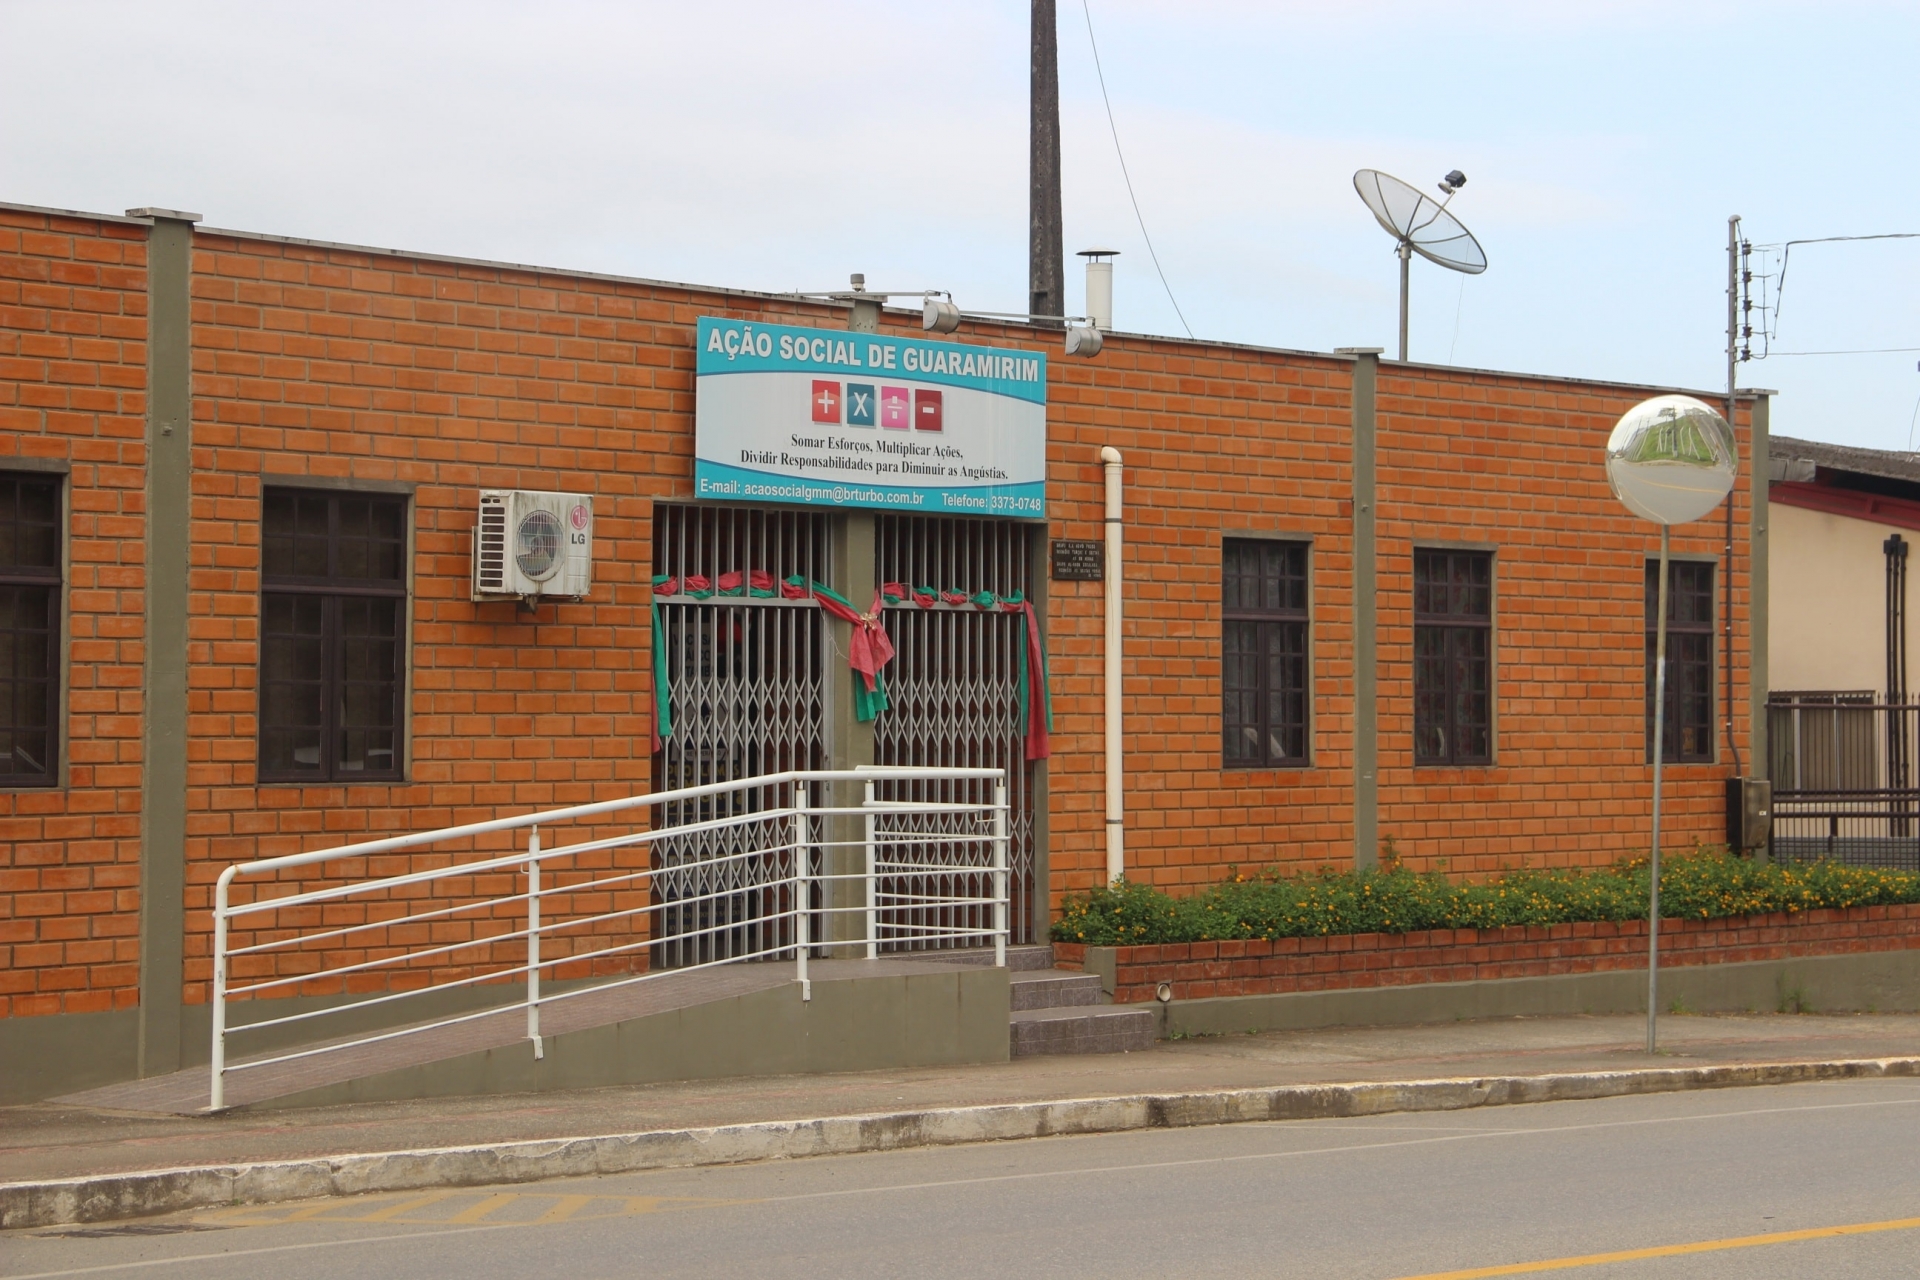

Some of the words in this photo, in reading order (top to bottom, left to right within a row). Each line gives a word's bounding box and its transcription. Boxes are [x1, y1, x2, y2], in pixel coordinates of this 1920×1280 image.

[707, 326, 773, 361] AÇÃO
[779, 335, 862, 366] SOCIAL
[868, 343, 897, 370] DE
[903, 347, 1039, 382] GUARAMIRIM
[791, 434, 825, 449] Somar
[828, 436, 873, 454] Esforços,
[876, 440, 931, 458] Multiplicar
[933, 445, 963, 460] Ações,
[741, 449, 778, 464] Dividir
[781, 452, 873, 472] Responsabilidades
[876, 461, 898, 475] para
[901, 460, 945, 476] Diminuir
[948, 467, 958, 476] as
[960, 465, 1008, 481] Angústias.
[700, 478, 740, 494] E-mail:
[744, 482, 924, 504] acaosocialgmm@brturbo.com.br
[941, 492, 988, 508] Telefone:
[991, 495, 1042, 511] 3373-0748
[571, 533, 585, 545] LG
